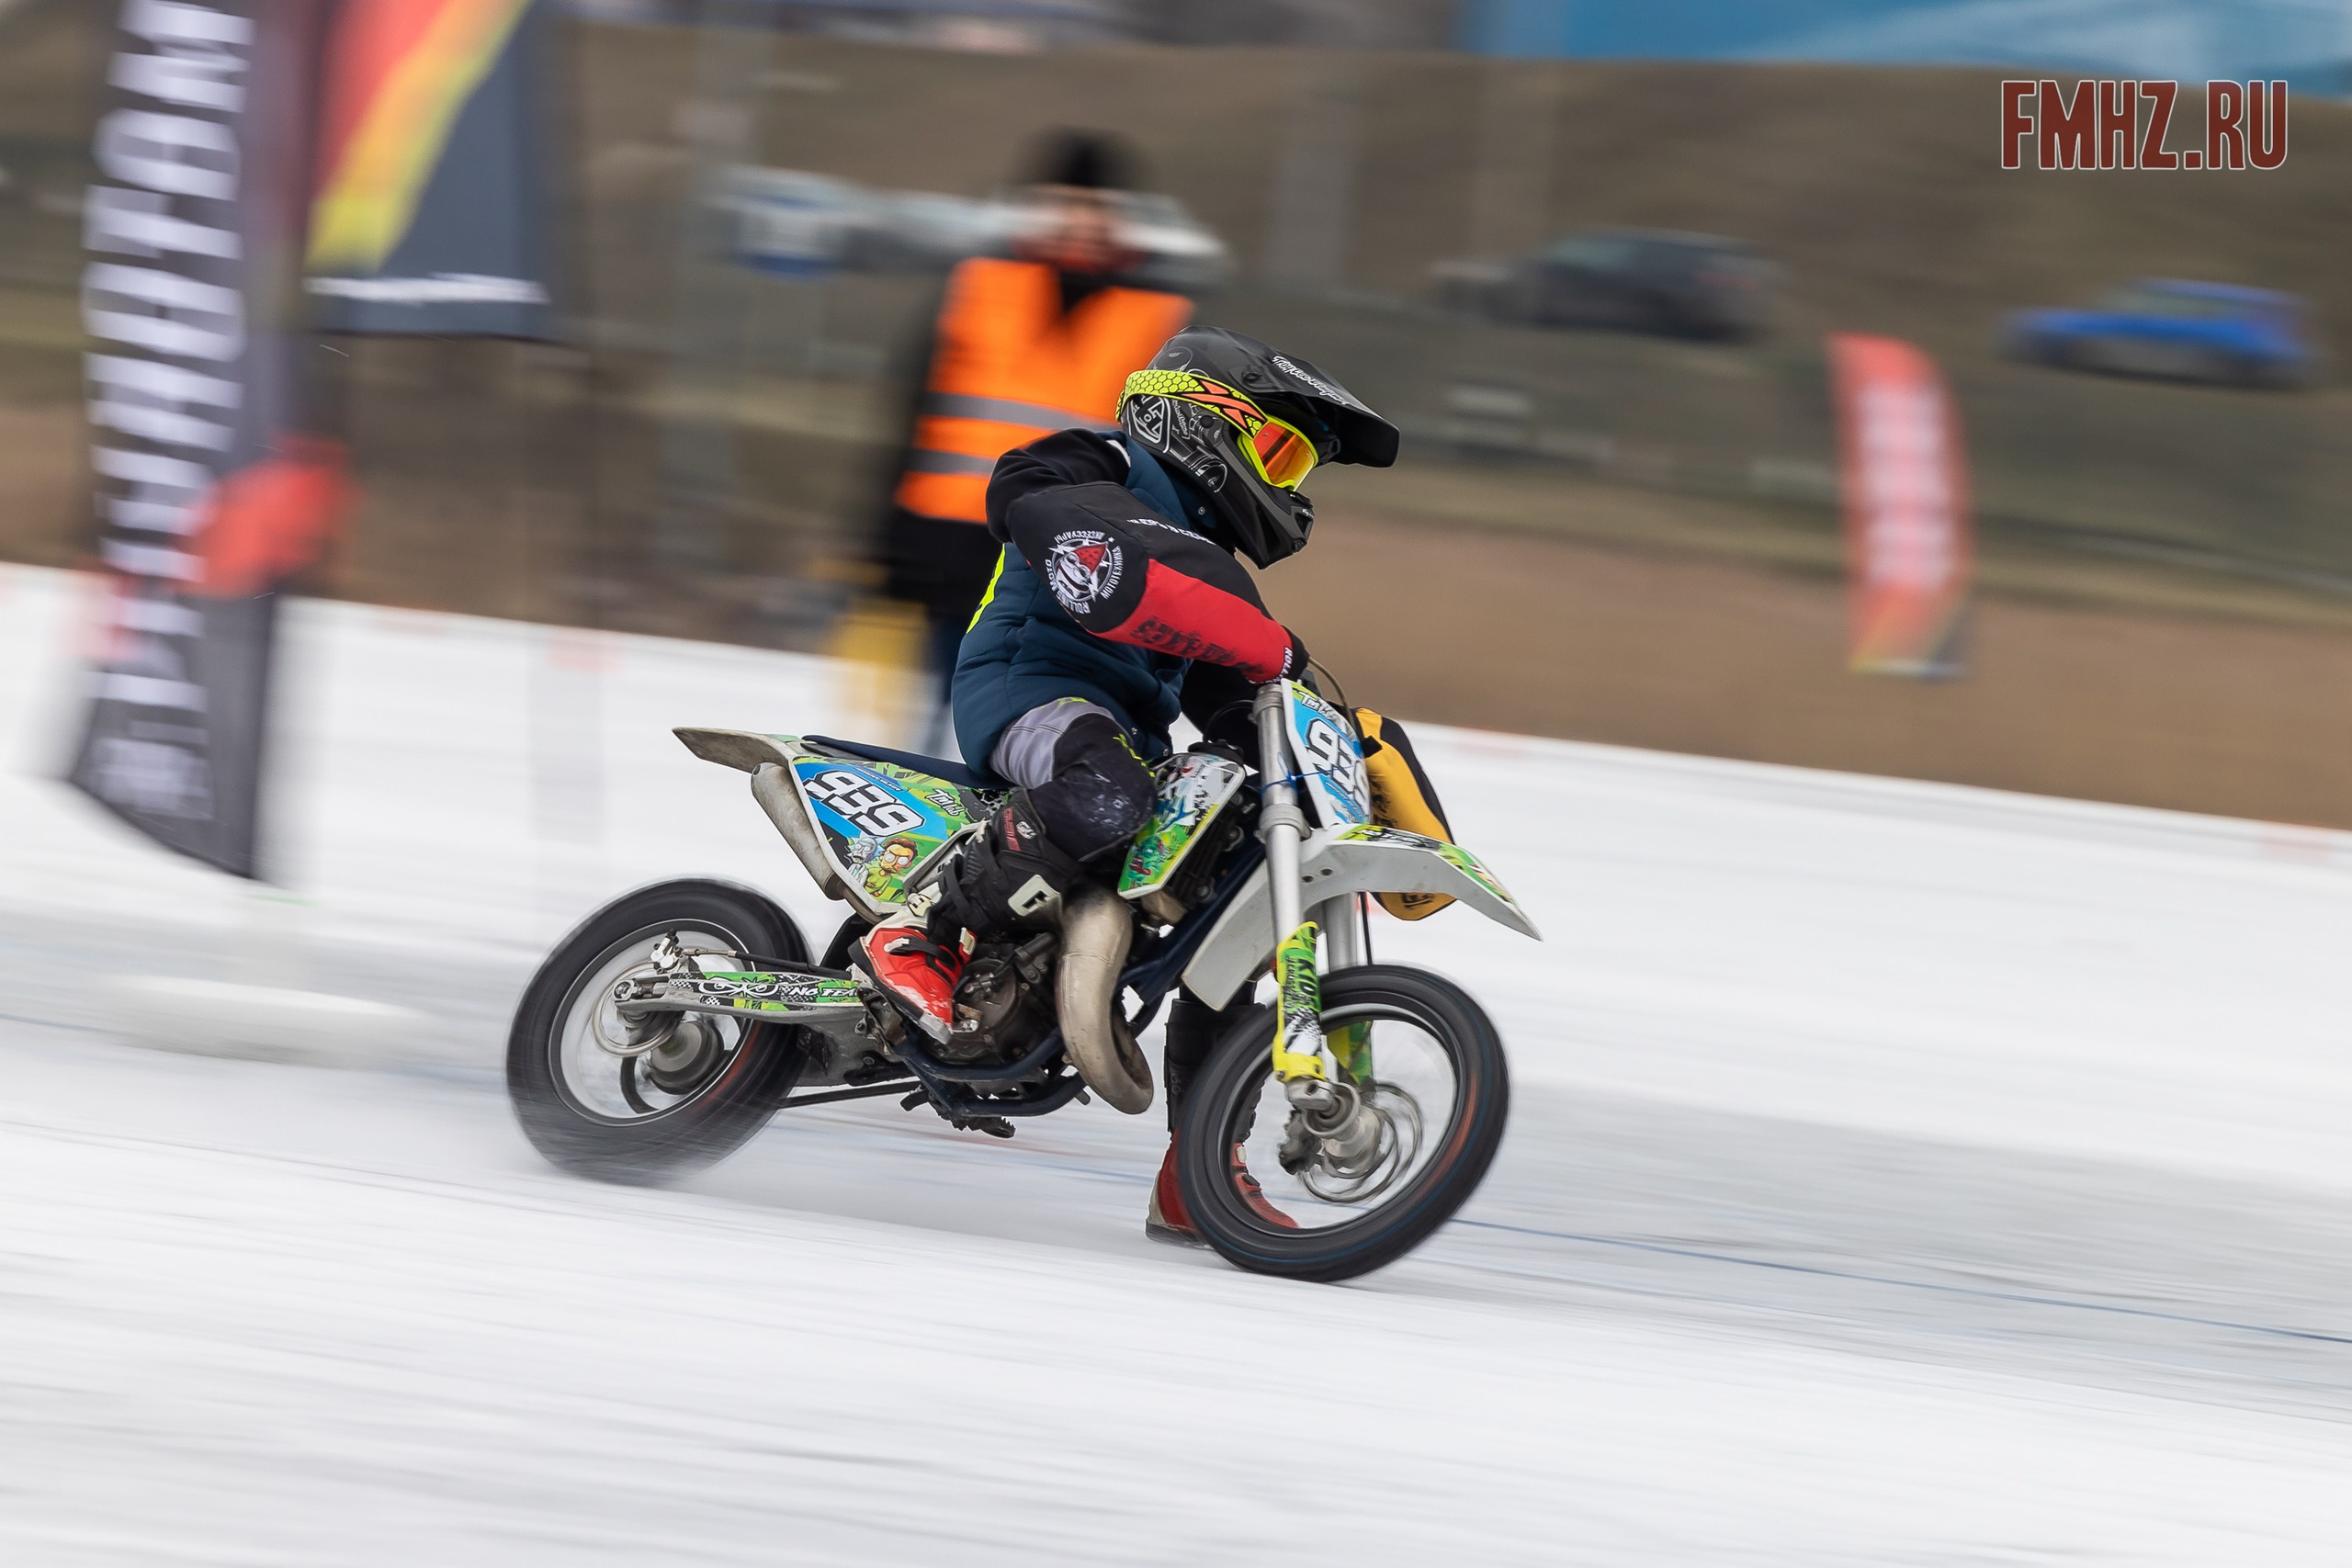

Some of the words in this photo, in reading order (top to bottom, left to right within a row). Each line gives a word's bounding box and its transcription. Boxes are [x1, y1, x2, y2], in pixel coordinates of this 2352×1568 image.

[1045, 558, 1059, 592] MOTO
[801, 769, 926, 838] 939
[789, 987, 820, 997] NO
[820, 987, 858, 997] FEA
